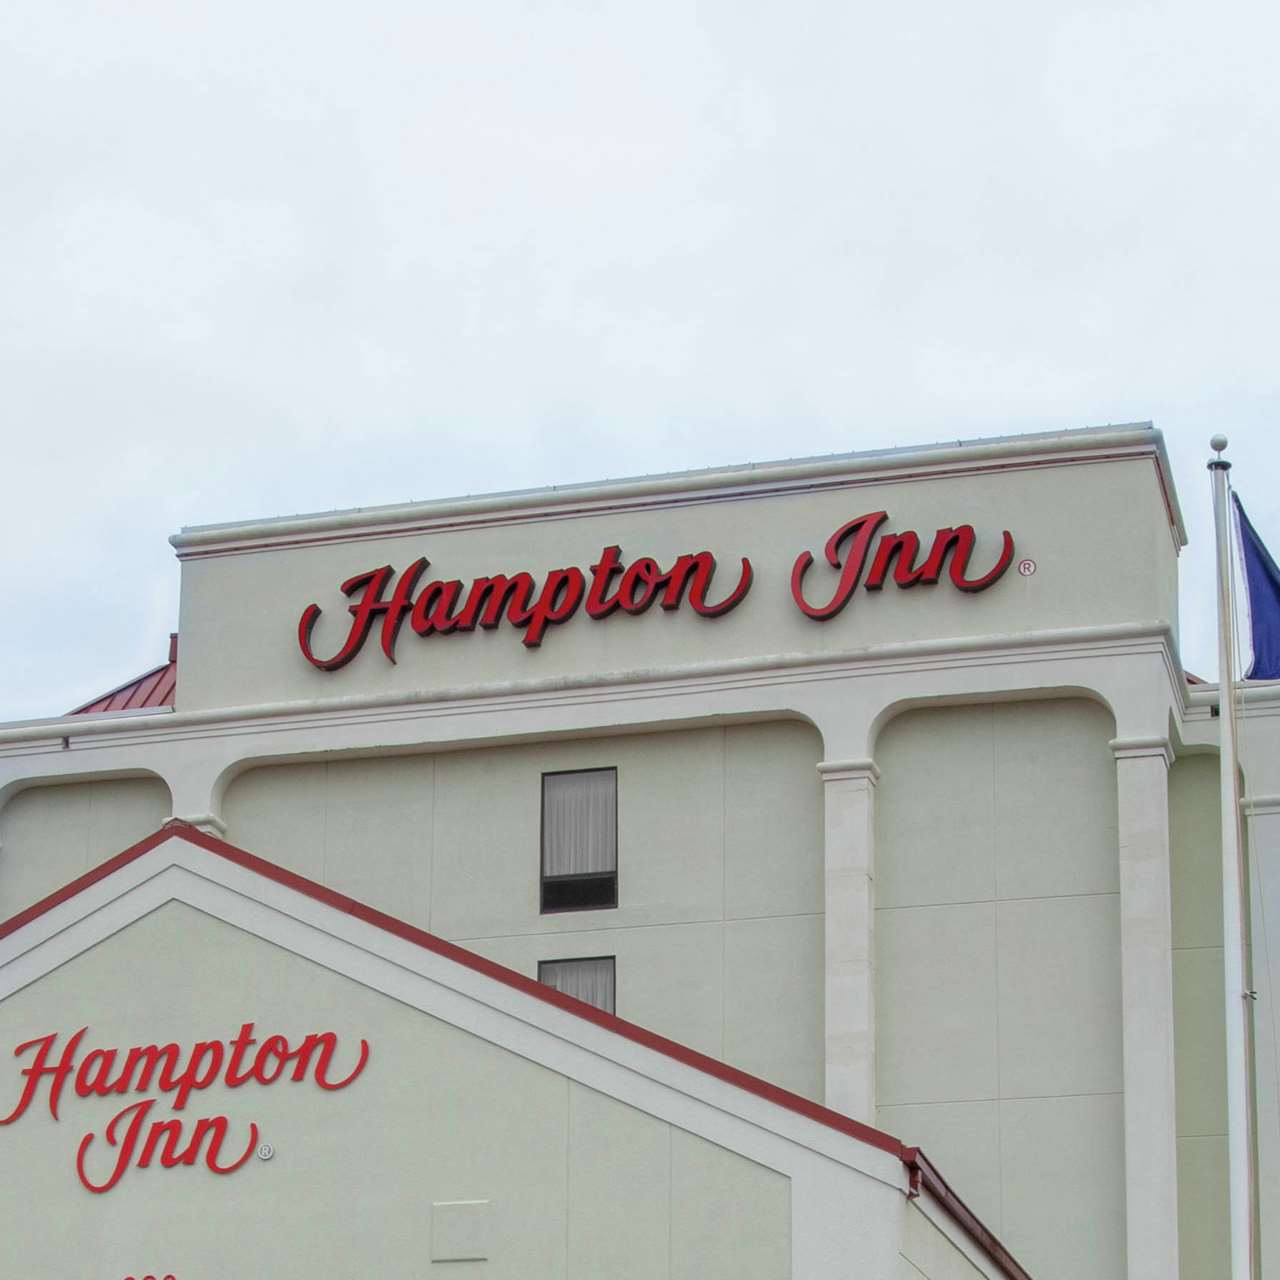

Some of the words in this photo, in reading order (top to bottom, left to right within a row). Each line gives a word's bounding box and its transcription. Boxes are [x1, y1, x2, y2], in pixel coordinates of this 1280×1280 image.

[297, 545, 753, 672] Hampton
[789, 510, 1015, 622] Inn
[76, 1098, 260, 1194] Inn
